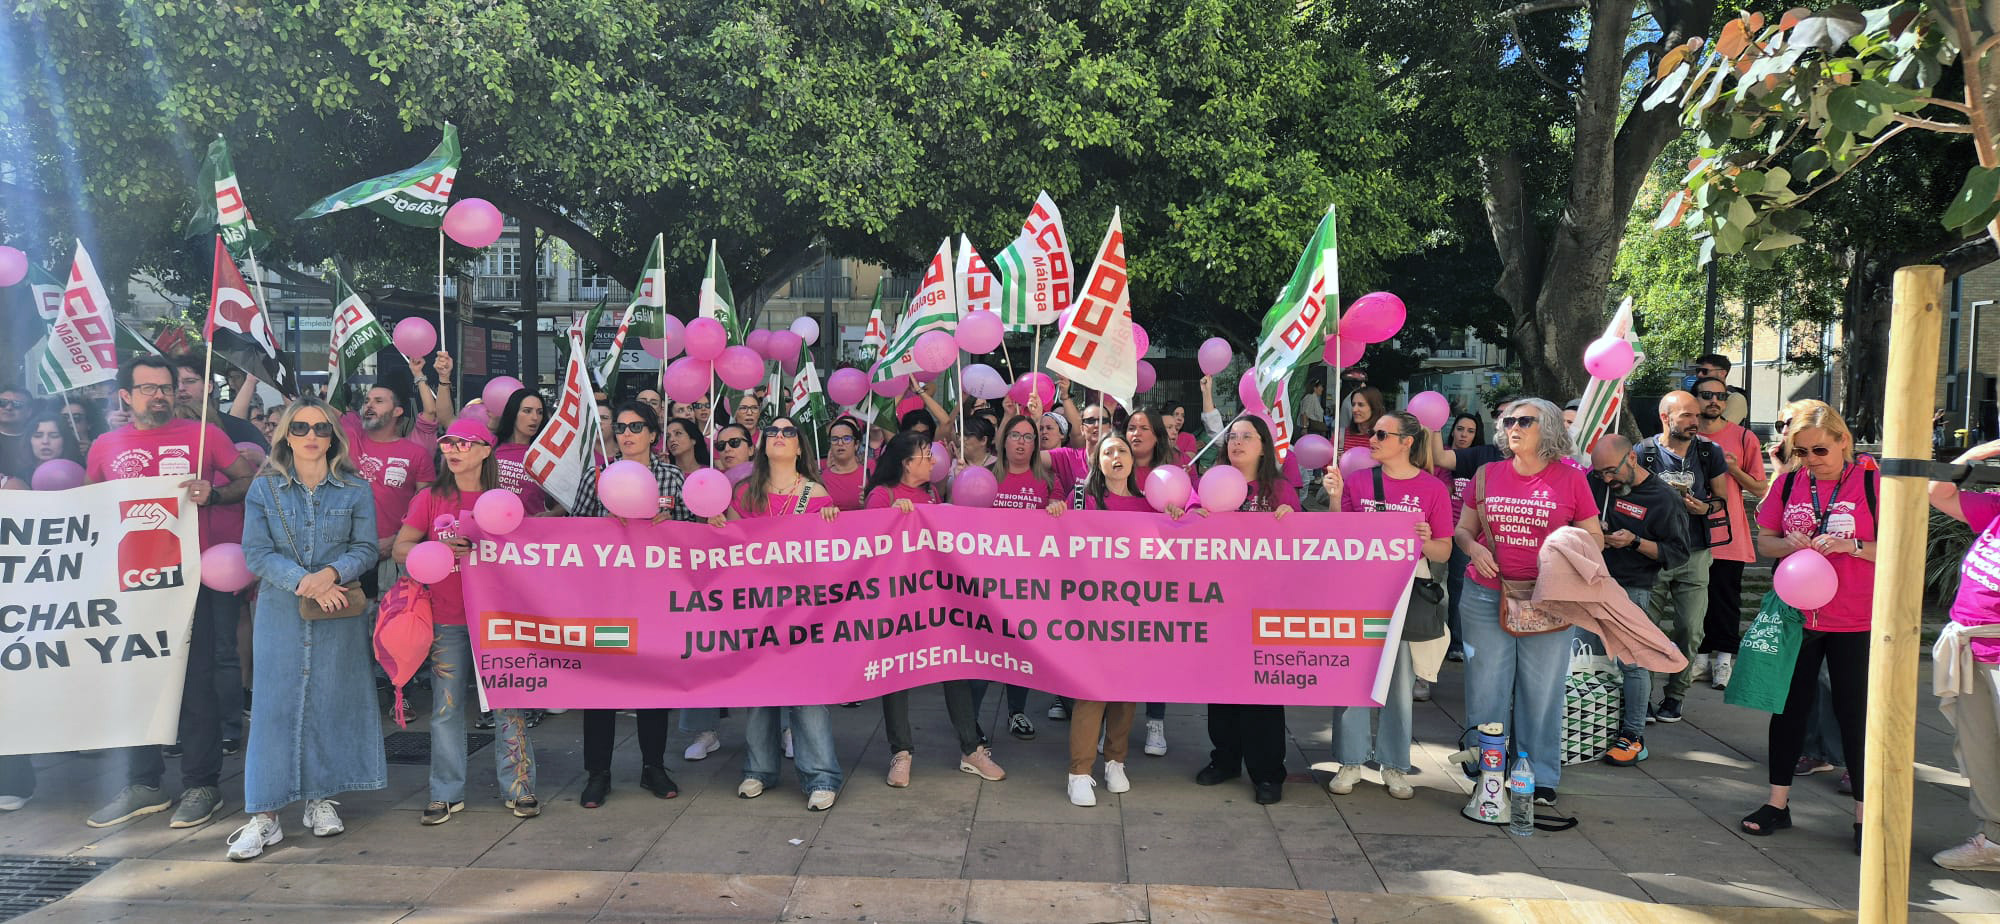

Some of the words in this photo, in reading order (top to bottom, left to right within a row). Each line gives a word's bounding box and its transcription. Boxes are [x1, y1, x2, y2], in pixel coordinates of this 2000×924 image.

[1032, 256, 1049, 312] Málaga
[55, 323, 93, 373] Málaga
[1485, 496, 1557, 510] PROFESIONALES
[1536, 509, 1550, 518] EN
[0, 514, 100, 547] NEN,
[1495, 534, 1505, 543] en
[1500, 524, 1532, 535] SOCIAL
[469, 539, 584, 567] ¡BASTA
[593, 543, 636, 568] YA
[645, 545, 682, 569] DE
[689, 534, 893, 571] PRECARIEDAD
[902, 528, 1031, 557] LABORAL
[1039, 535, 1060, 558] A
[1069, 535, 1130, 559] PTIS
[1139, 537, 1415, 561] EXTERNALIZADAS!
[123, 566, 179, 588] CGT
[669, 589, 723, 613] LAS
[732, 577, 880, 610] EMPRESAS
[889, 569, 1051, 600] INCUMPLEN
[1060, 579, 1179, 607] PORQUE
[1188, 581, 1224, 604] LA
[487, 618, 587, 647] CCOO
[680, 625, 780, 660] JUNTA
[788, 623, 824, 646] DE
[832, 606, 994, 643] ANDALUCIA
[1002, 618, 1038, 641] LO
[1046, 619, 1208, 643] CONSIENTE
[1259, 616, 1356, 639] CCOO
[85, 630, 171, 664] YA!
[1253, 650, 1350, 667] Enseñanza
[481, 652, 582, 670] Enseñanza
[863, 644, 1034, 682] #PTISEnLucha
[481, 673, 548, 692] Málaga
[1254, 670, 1318, 689] Málaga
